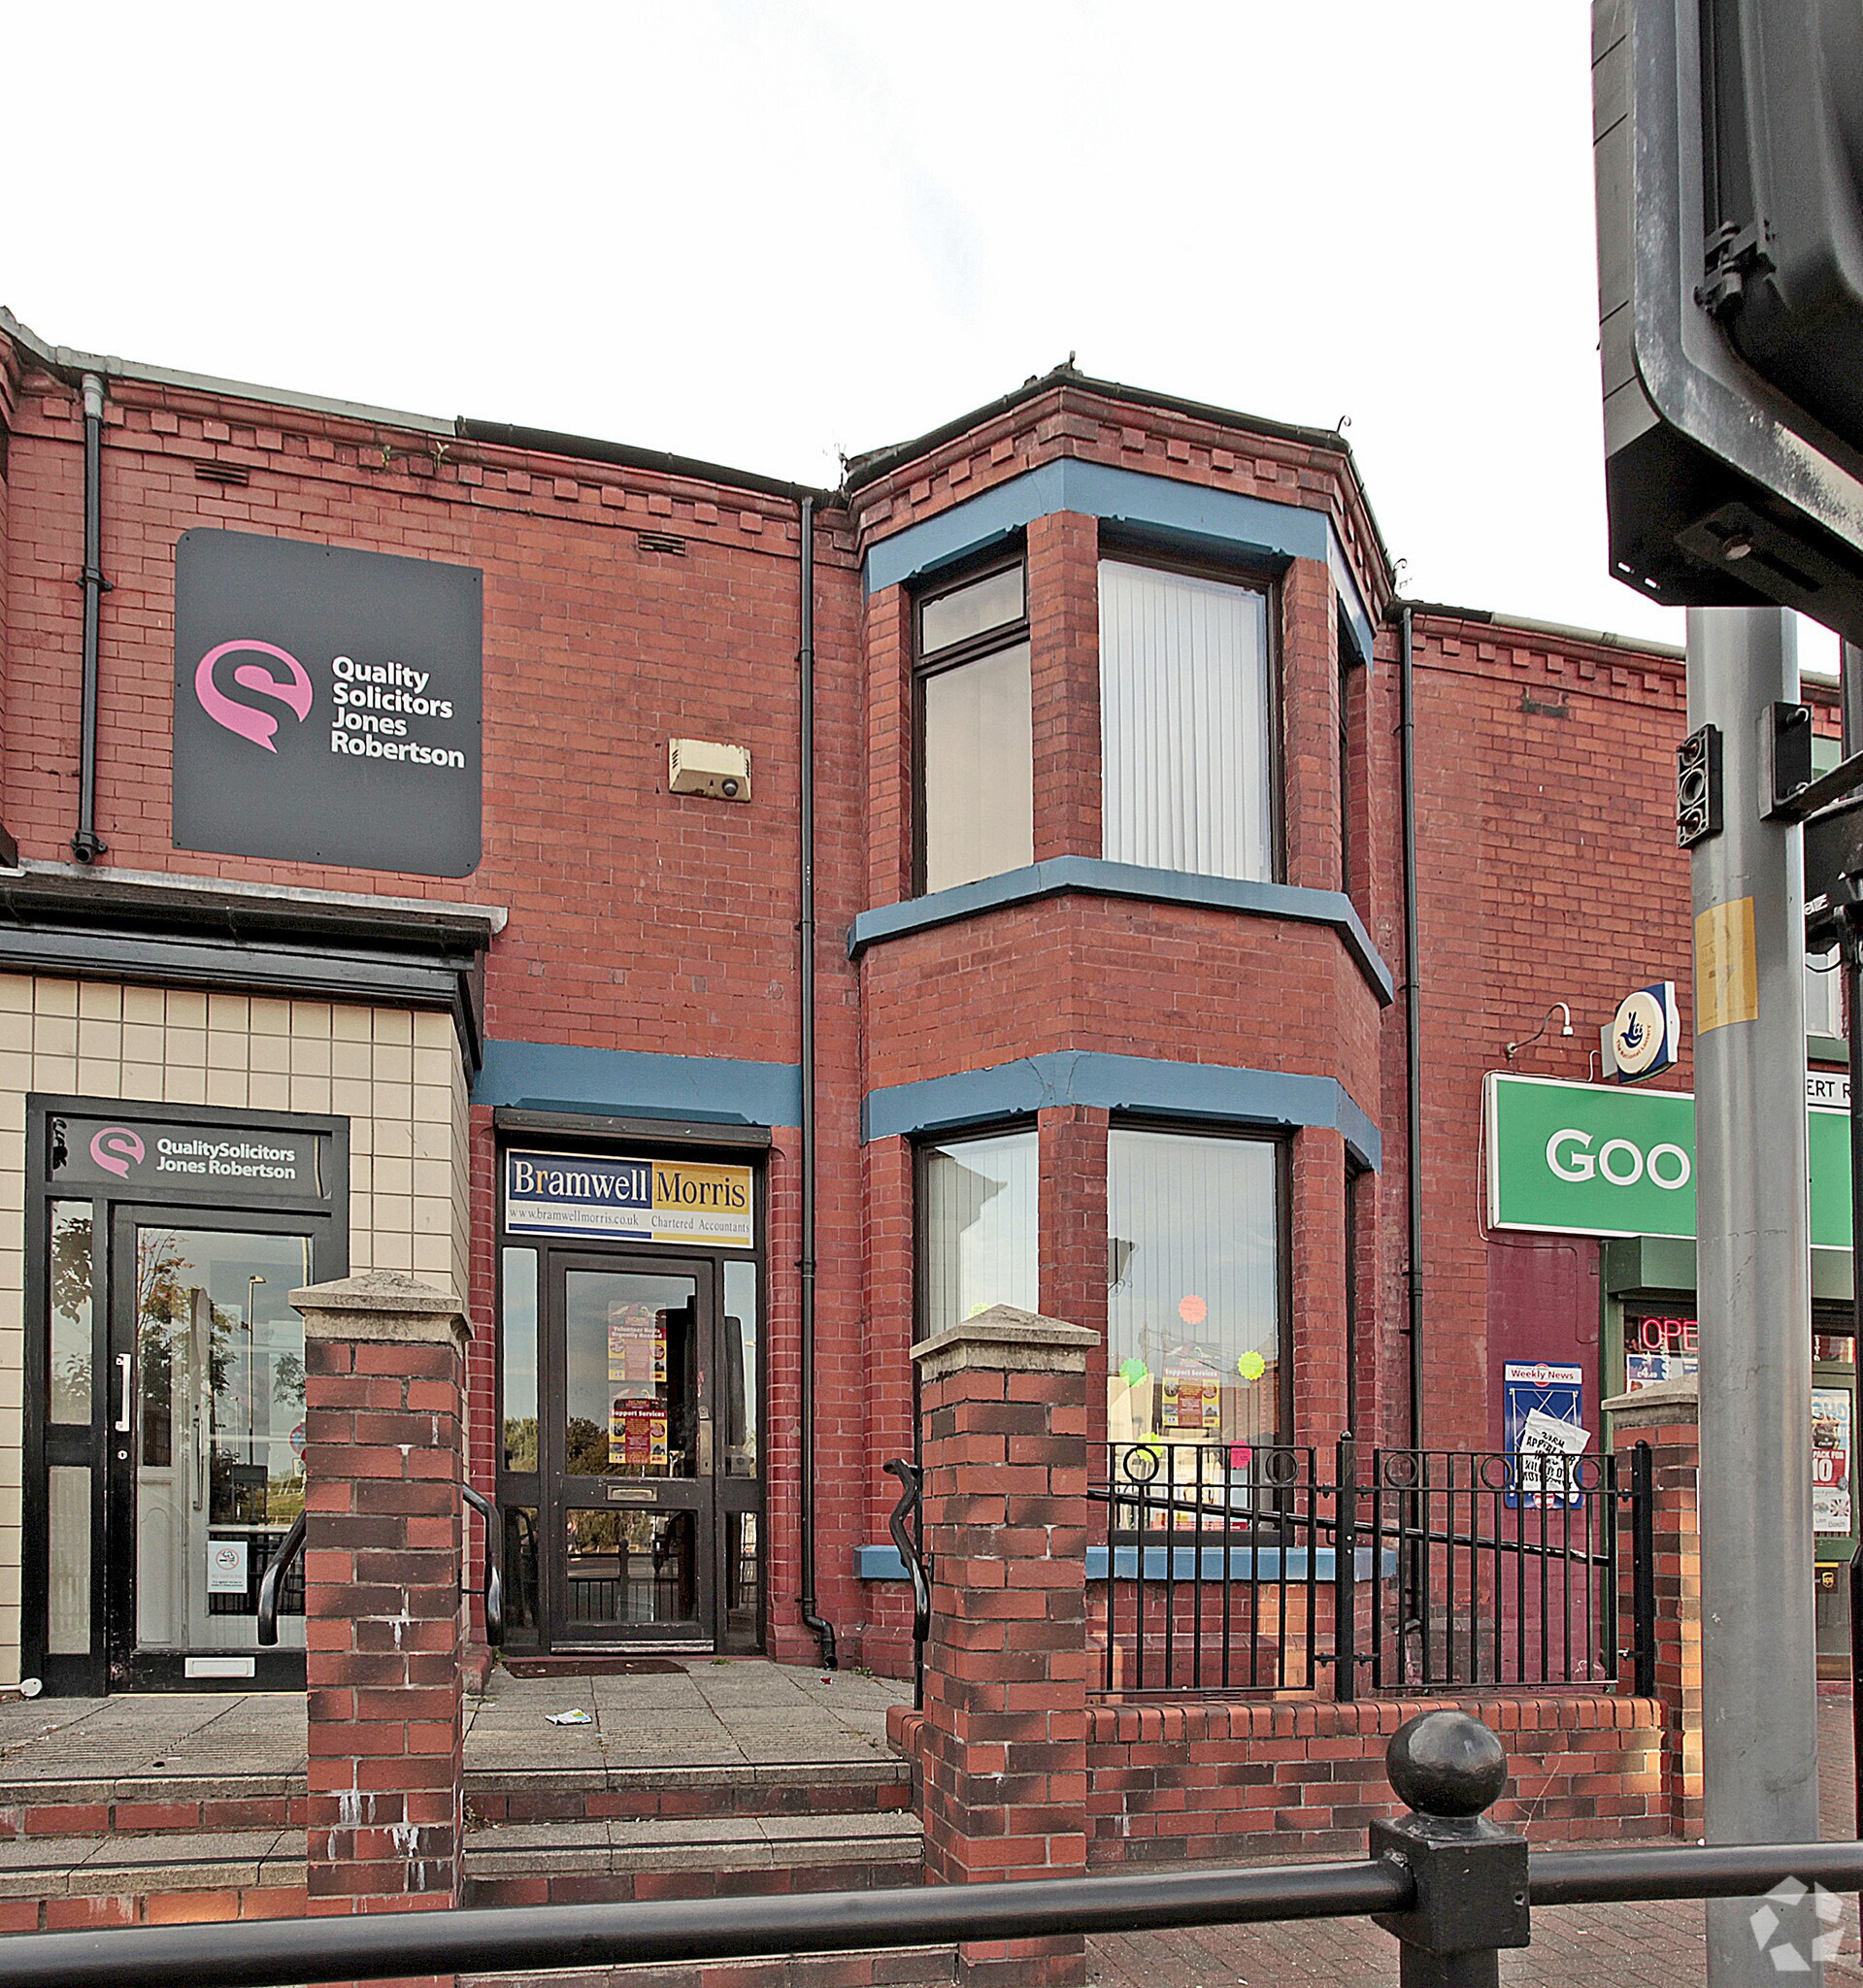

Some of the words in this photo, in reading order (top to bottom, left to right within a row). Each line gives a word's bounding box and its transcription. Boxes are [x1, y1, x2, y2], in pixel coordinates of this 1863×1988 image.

[332, 655, 430, 694] Quality
[332, 681, 453, 719] Solicitors
[331, 706, 408, 737] Jones
[331, 730, 465, 769] Robertson
[156, 1138, 296, 1162] QualitySolicitors
[155, 1156, 207, 1174] Jones
[208, 1159, 296, 1179] Robertson
[514, 1160, 648, 1202] Bramwell
[656, 1171, 746, 1209] Morris
[509, 1208, 640, 1226] www.bramwellmorris.co.uk
[651, 1214, 694, 1230] Chartered
[699, 1219, 750, 1234] Accountants
[1165, 1368, 1189, 1377] Support
[1191, 1368, 1217, 1377] Services
[1511, 1369, 1546, 1380] Weekly
[1547, 1371, 1575, 1379] News
[1831, 1451, 1845, 1460] FOR
